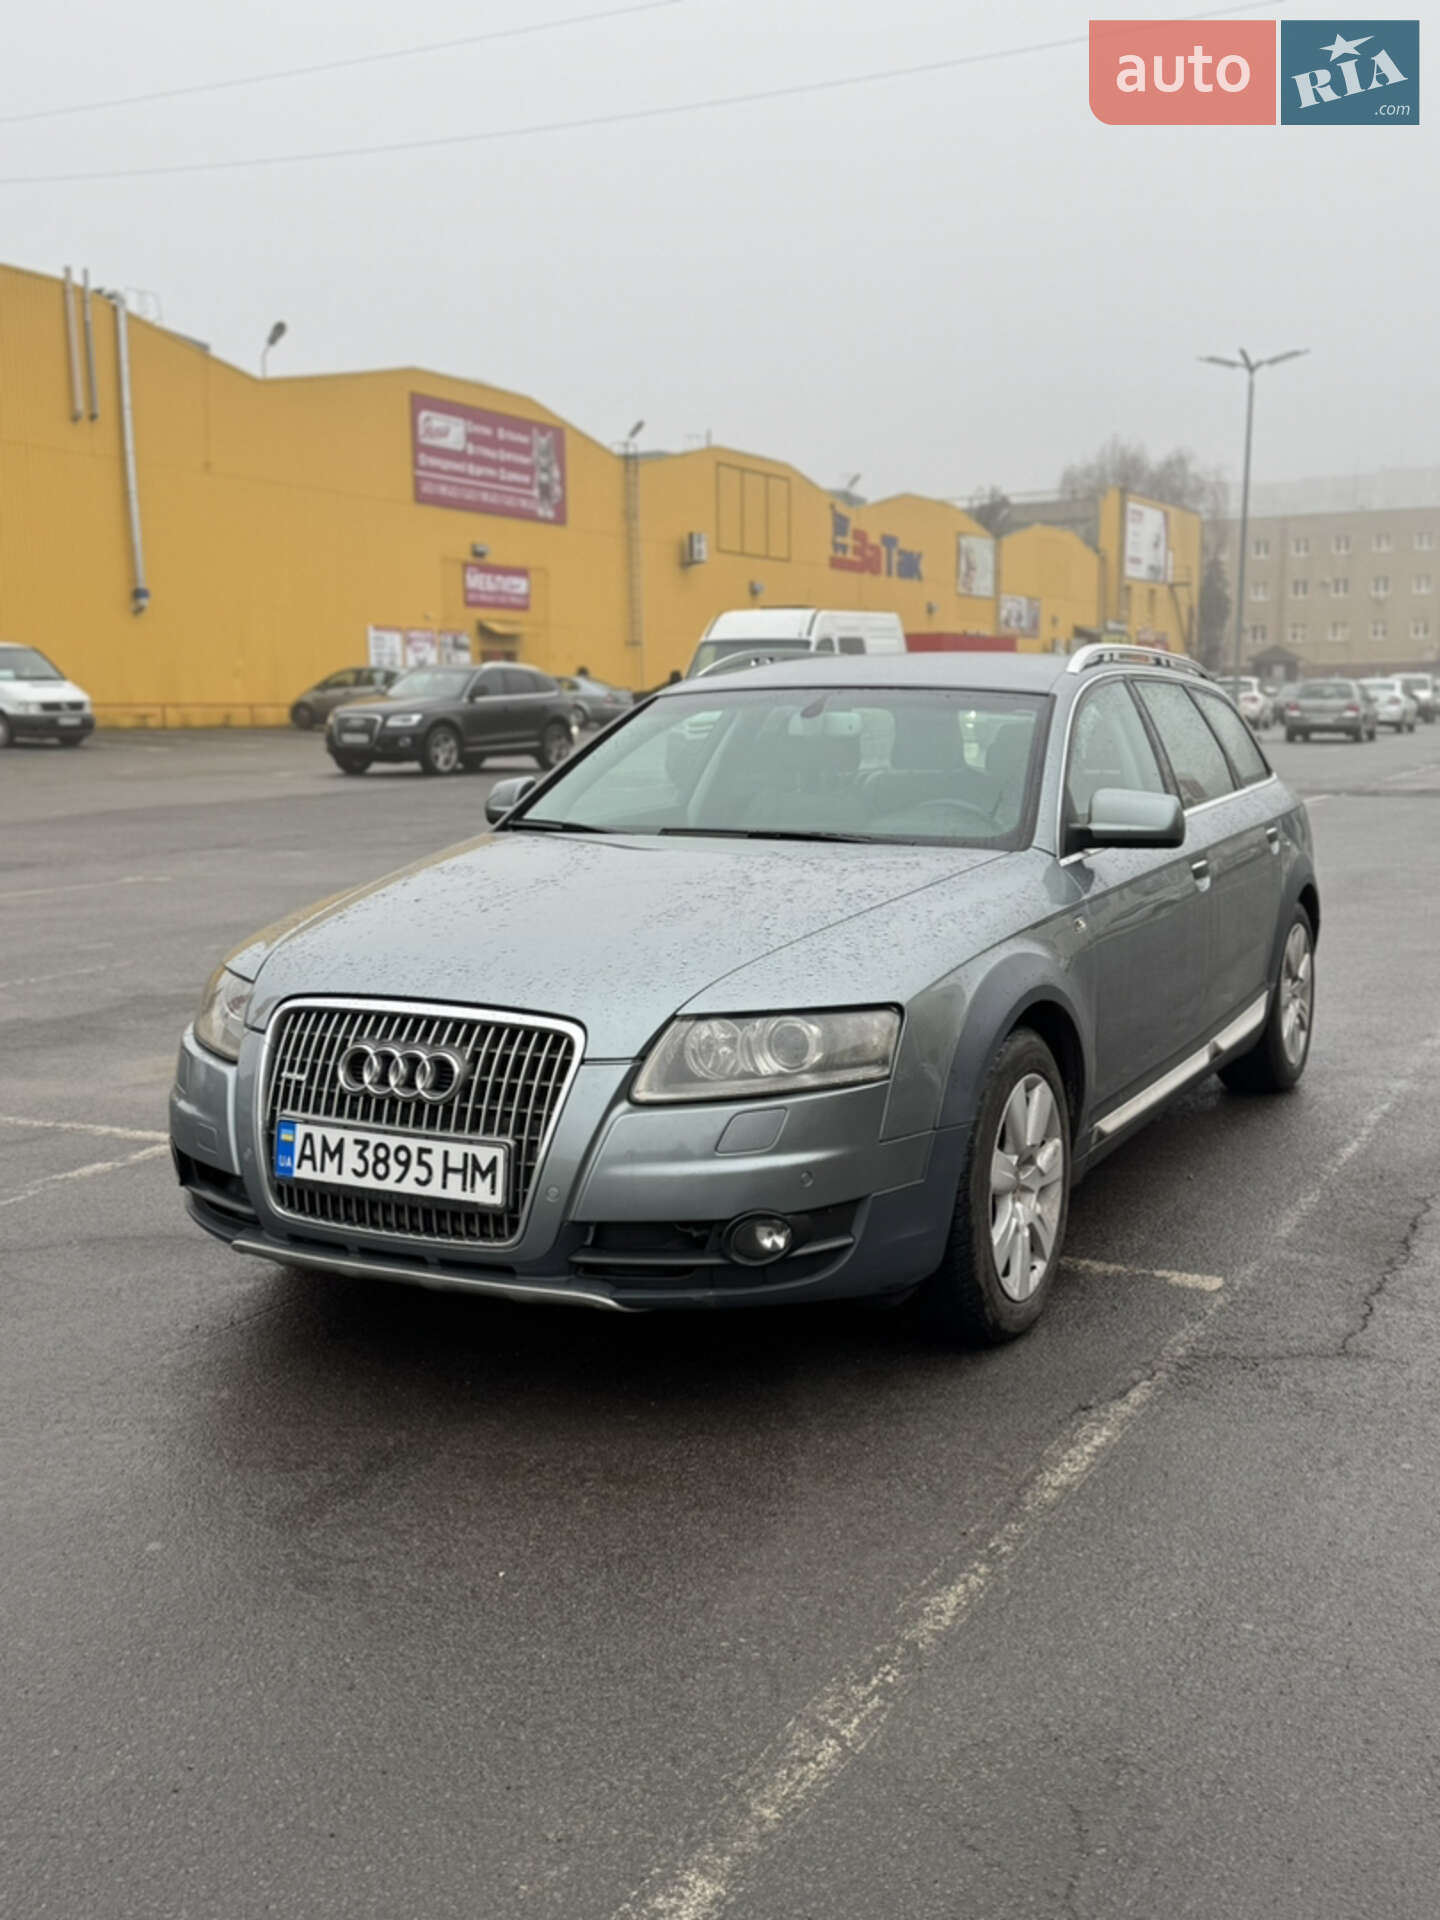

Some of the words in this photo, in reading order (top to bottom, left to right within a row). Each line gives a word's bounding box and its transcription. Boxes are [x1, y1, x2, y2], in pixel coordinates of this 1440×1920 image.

[278, 1154, 293, 1168] UA
[296, 1132, 345, 1176] AM
[351, 1138, 433, 1188] 3895
[441, 1149, 498, 1196] HM
